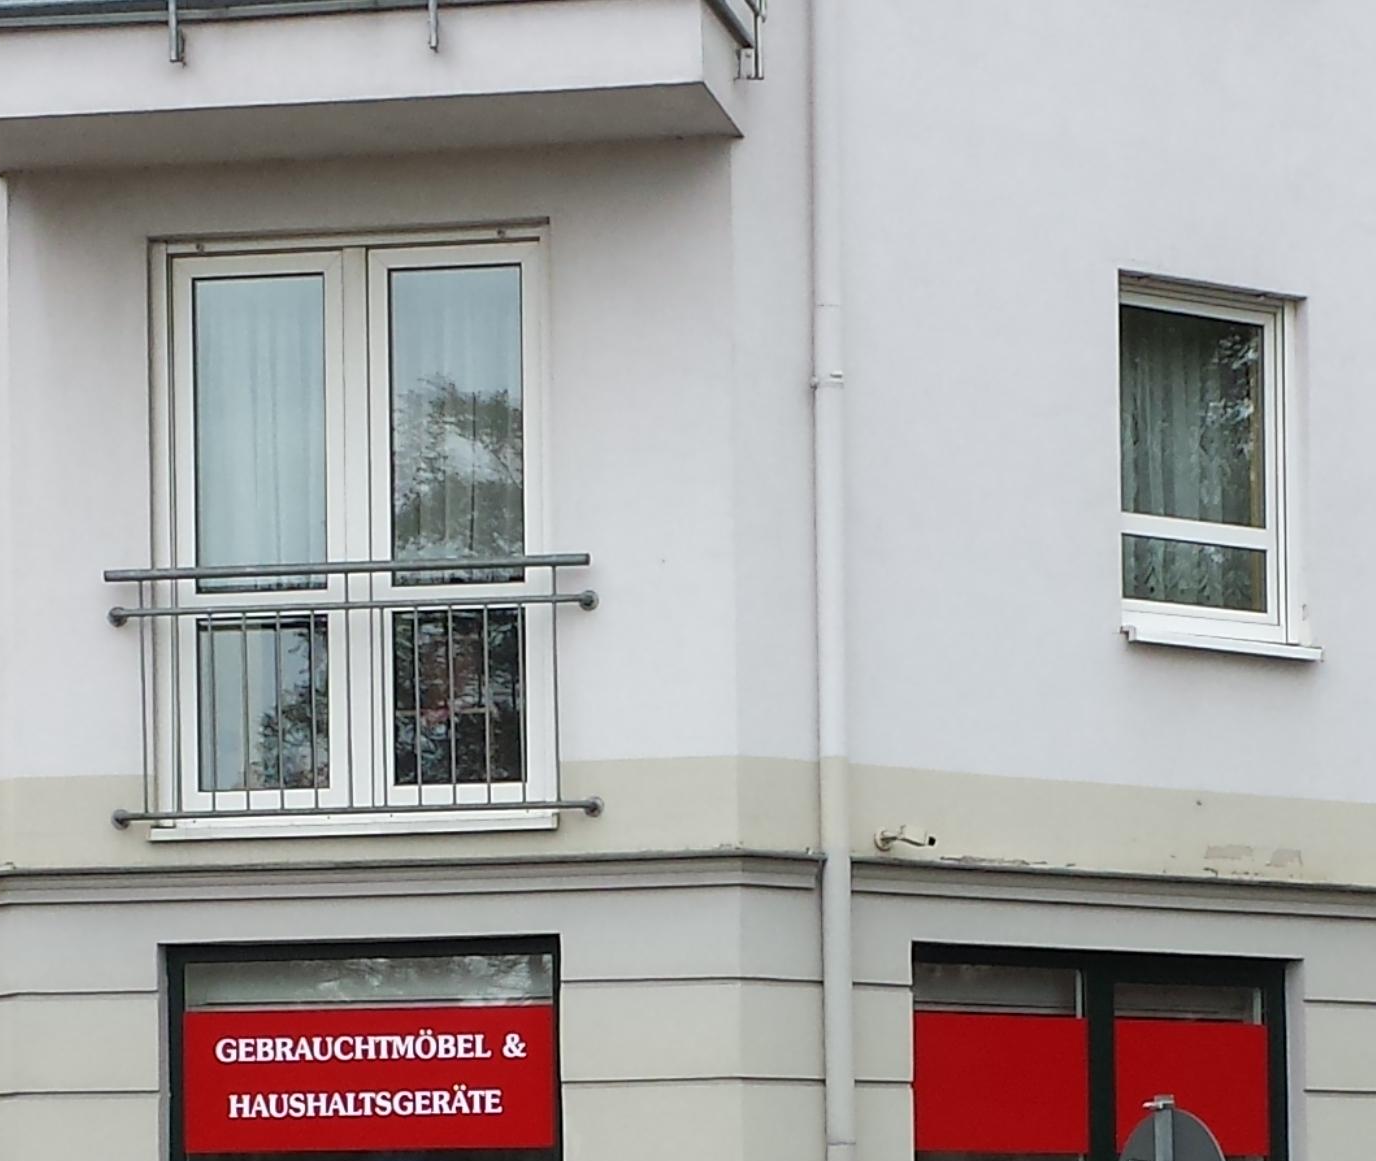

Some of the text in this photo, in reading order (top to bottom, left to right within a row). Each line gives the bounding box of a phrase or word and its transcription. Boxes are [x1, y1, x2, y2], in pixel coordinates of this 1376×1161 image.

[215, 1029, 526, 1063] GEBRAUCHTMÖBEL &
[228, 1085, 503, 1118] HAUSHALTSGERÄTE
